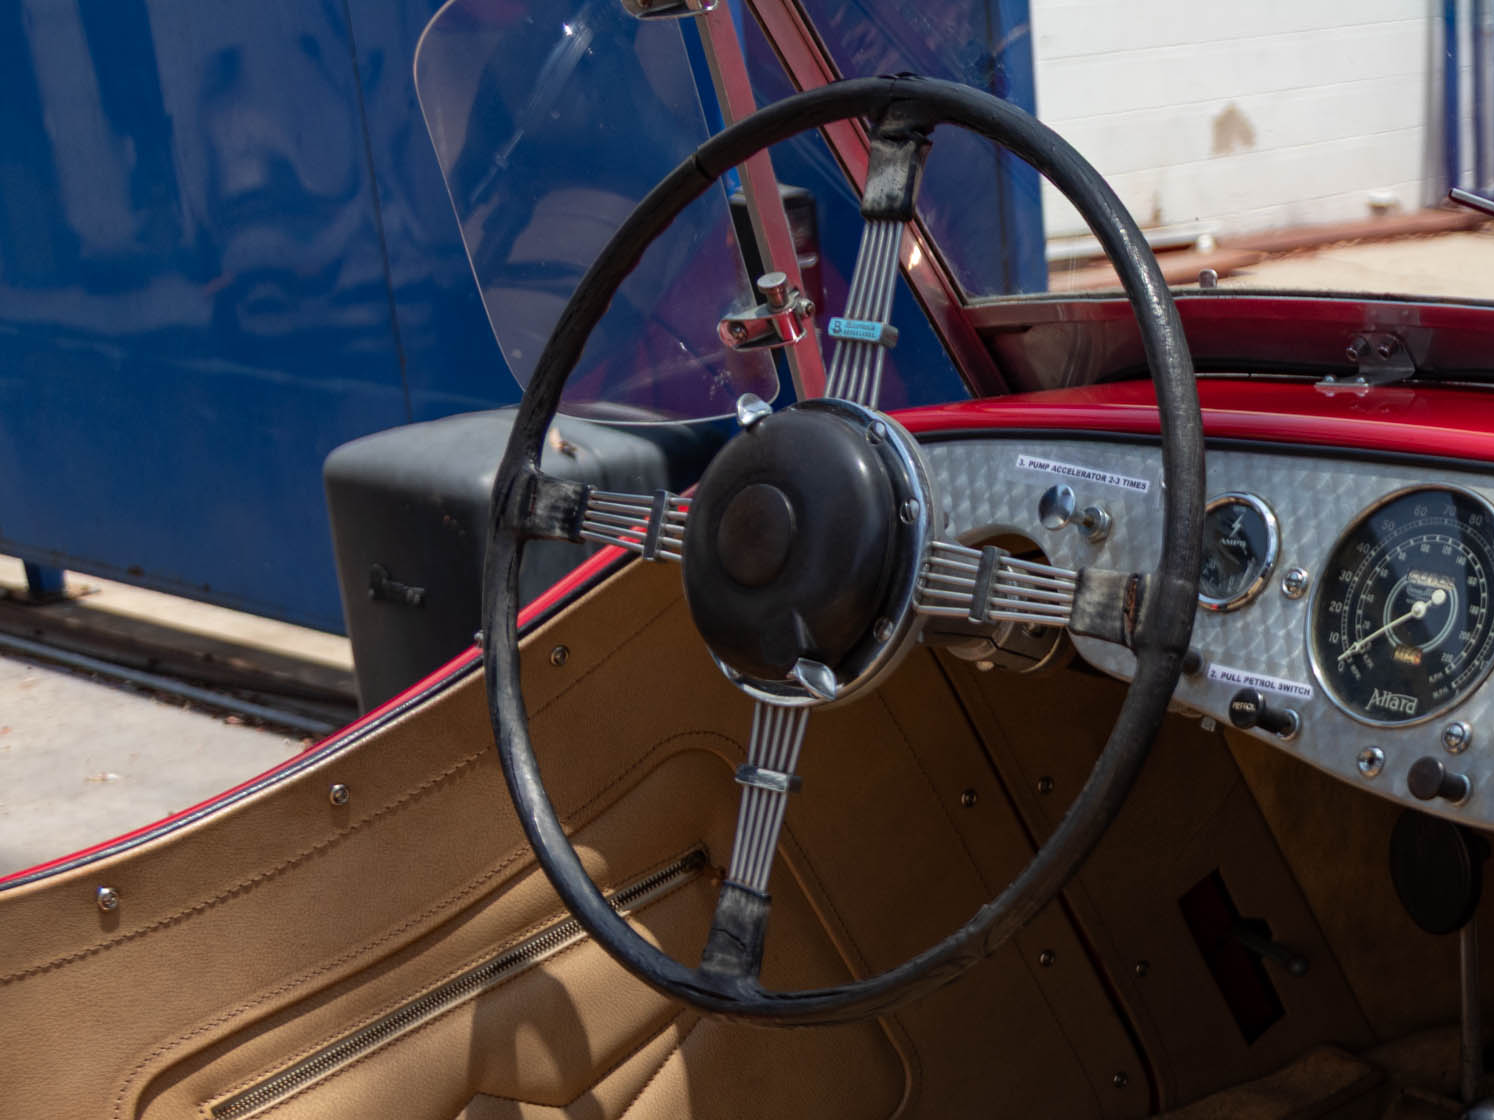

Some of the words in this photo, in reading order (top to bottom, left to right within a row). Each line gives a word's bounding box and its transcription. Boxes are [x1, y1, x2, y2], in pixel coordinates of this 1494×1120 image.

[1019, 458, 1026, 466] 3.
[1028, 460, 1050, 473] PUMP
[1051, 464, 1107, 482] ACCELERATOR
[1108, 475, 1120, 485] 2-3
[1122, 477, 1147, 490] TIMES
[1338, 570, 1352, 582] 30
[1329, 601, 1343, 614] 20
[1328, 632, 1339, 644] 10
[1338, 661, 1345, 673] 0
[1210, 670, 1217, 679] 2.
[1220, 672, 1241, 683] PULL
[1243, 676, 1275, 689] PETROL
[1278, 683, 1311, 696] SWITCH
[1365, 687, 1418, 715] Allard
